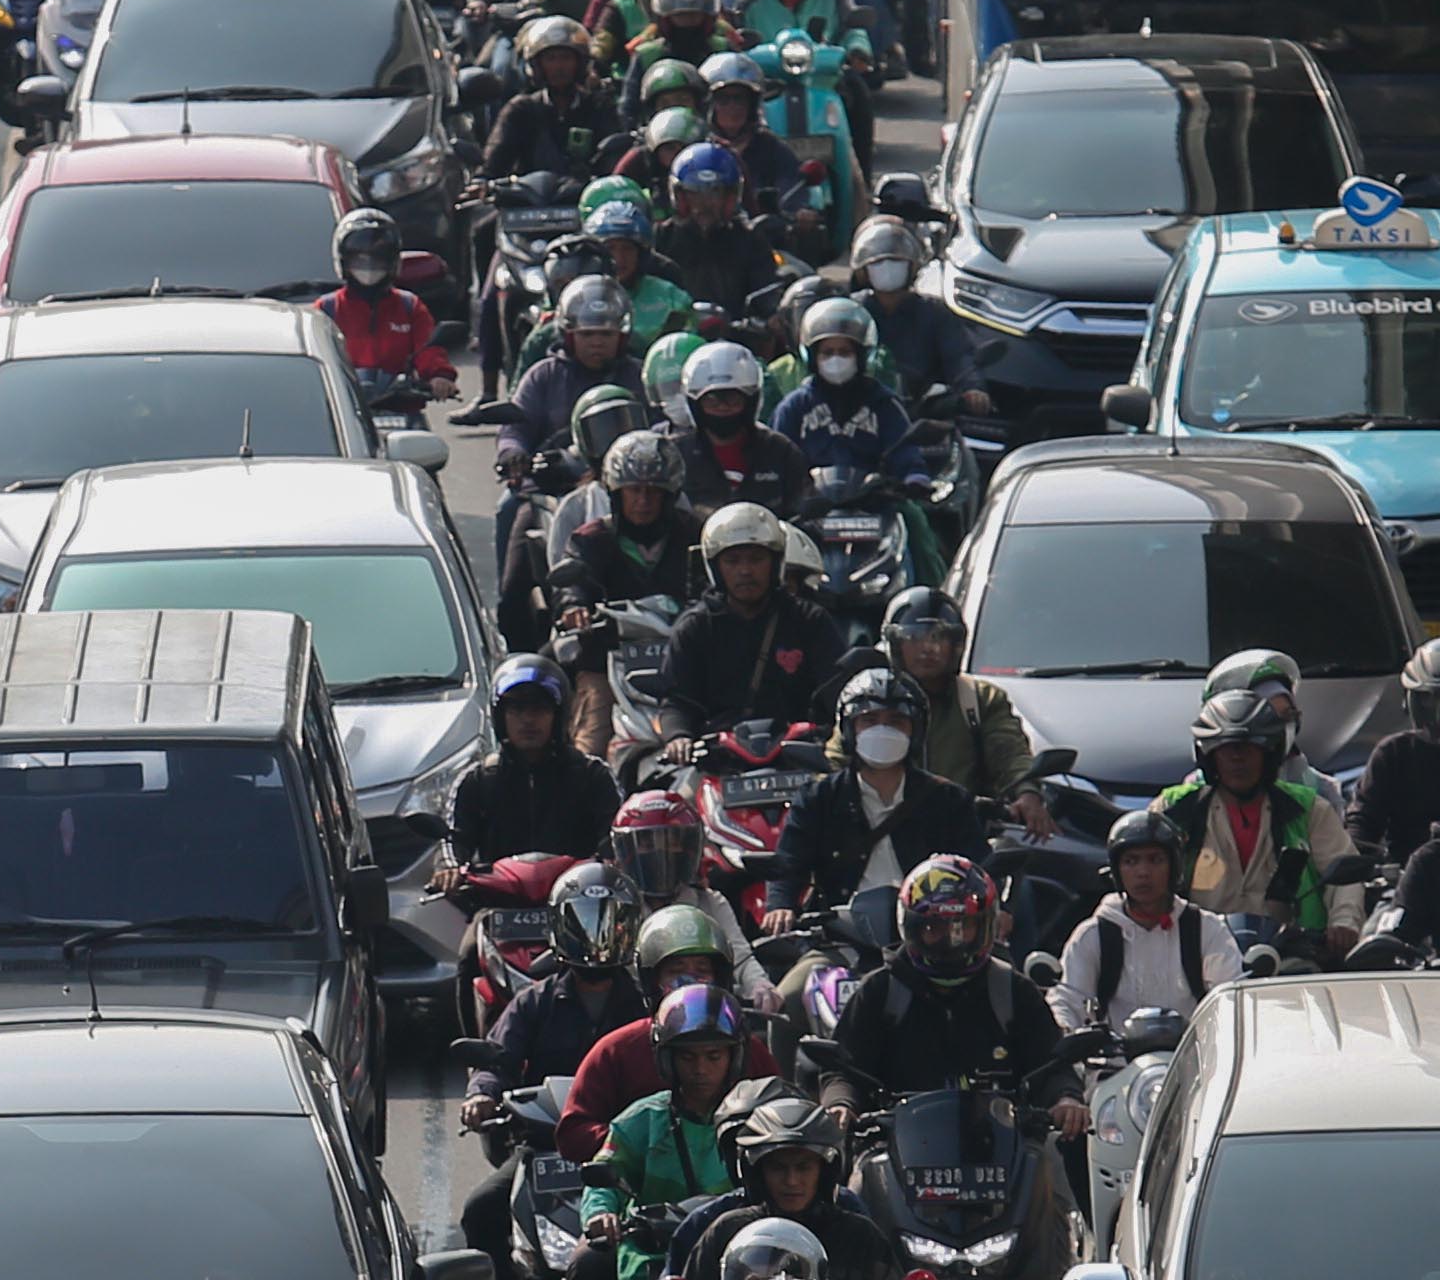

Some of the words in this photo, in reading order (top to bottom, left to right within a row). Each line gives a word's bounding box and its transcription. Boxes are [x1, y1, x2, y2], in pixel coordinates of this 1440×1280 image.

[1333, 228, 1411, 243] TAKSI
[1309, 297, 1433, 315] Bluebird
[494, 913, 504, 926] B
[537, 1161, 546, 1175] B
